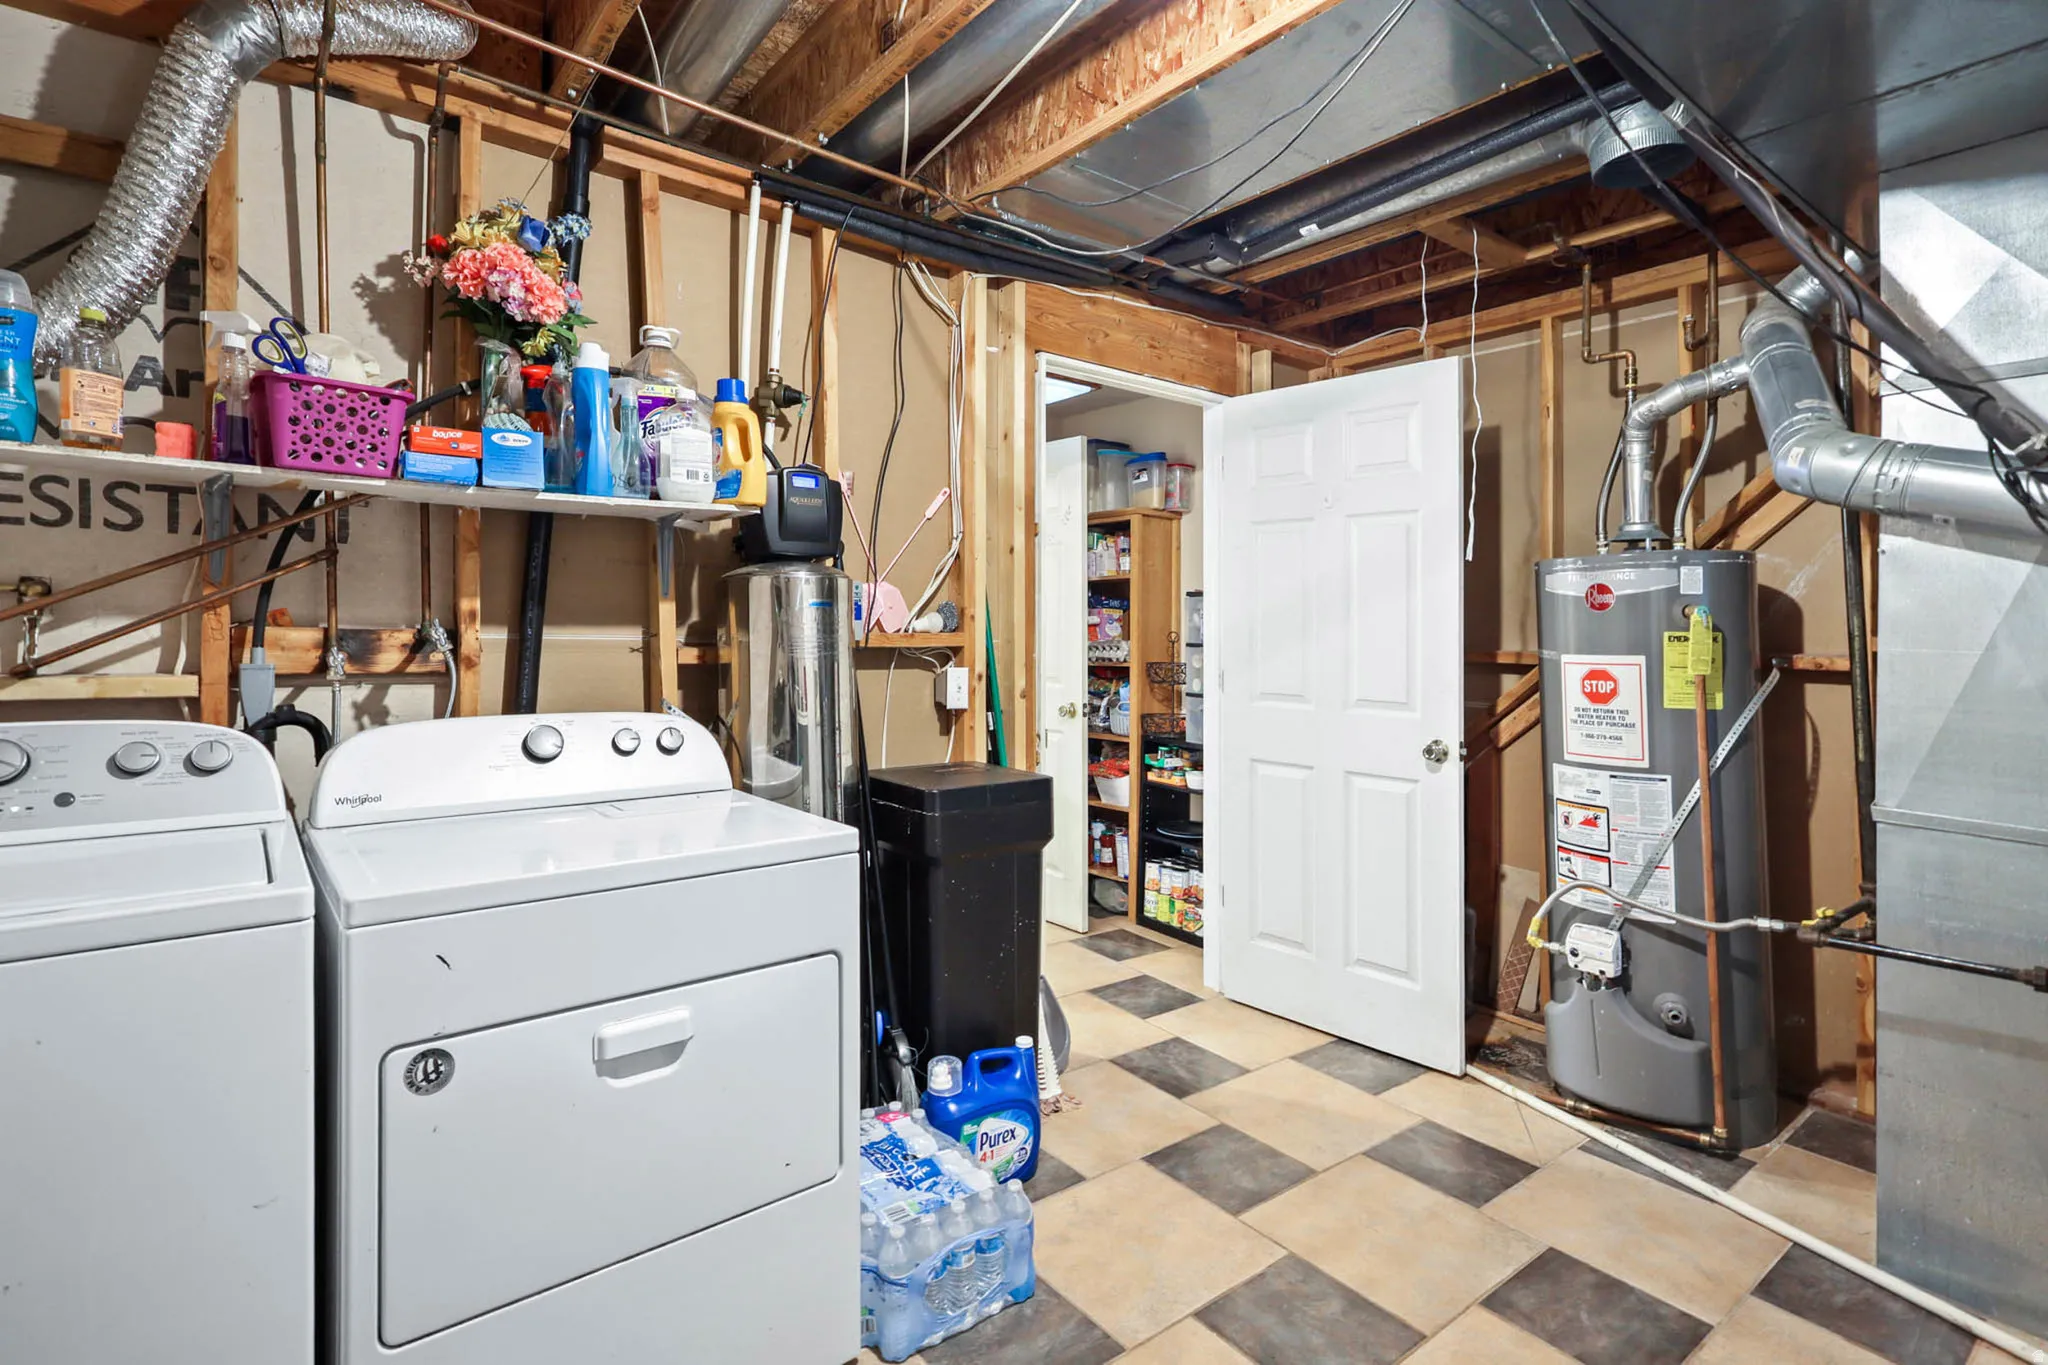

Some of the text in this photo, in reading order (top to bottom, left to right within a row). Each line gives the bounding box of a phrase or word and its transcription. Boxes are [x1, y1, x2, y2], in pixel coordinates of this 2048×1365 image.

[1585, 583, 1614, 608] Rheem
[1583, 679, 1615, 694] STOP
[1605, 721, 1636, 729] PURCHASE
[334, 793, 382, 808] Whirlpool
[979, 1127, 1017, 1152] Purex
